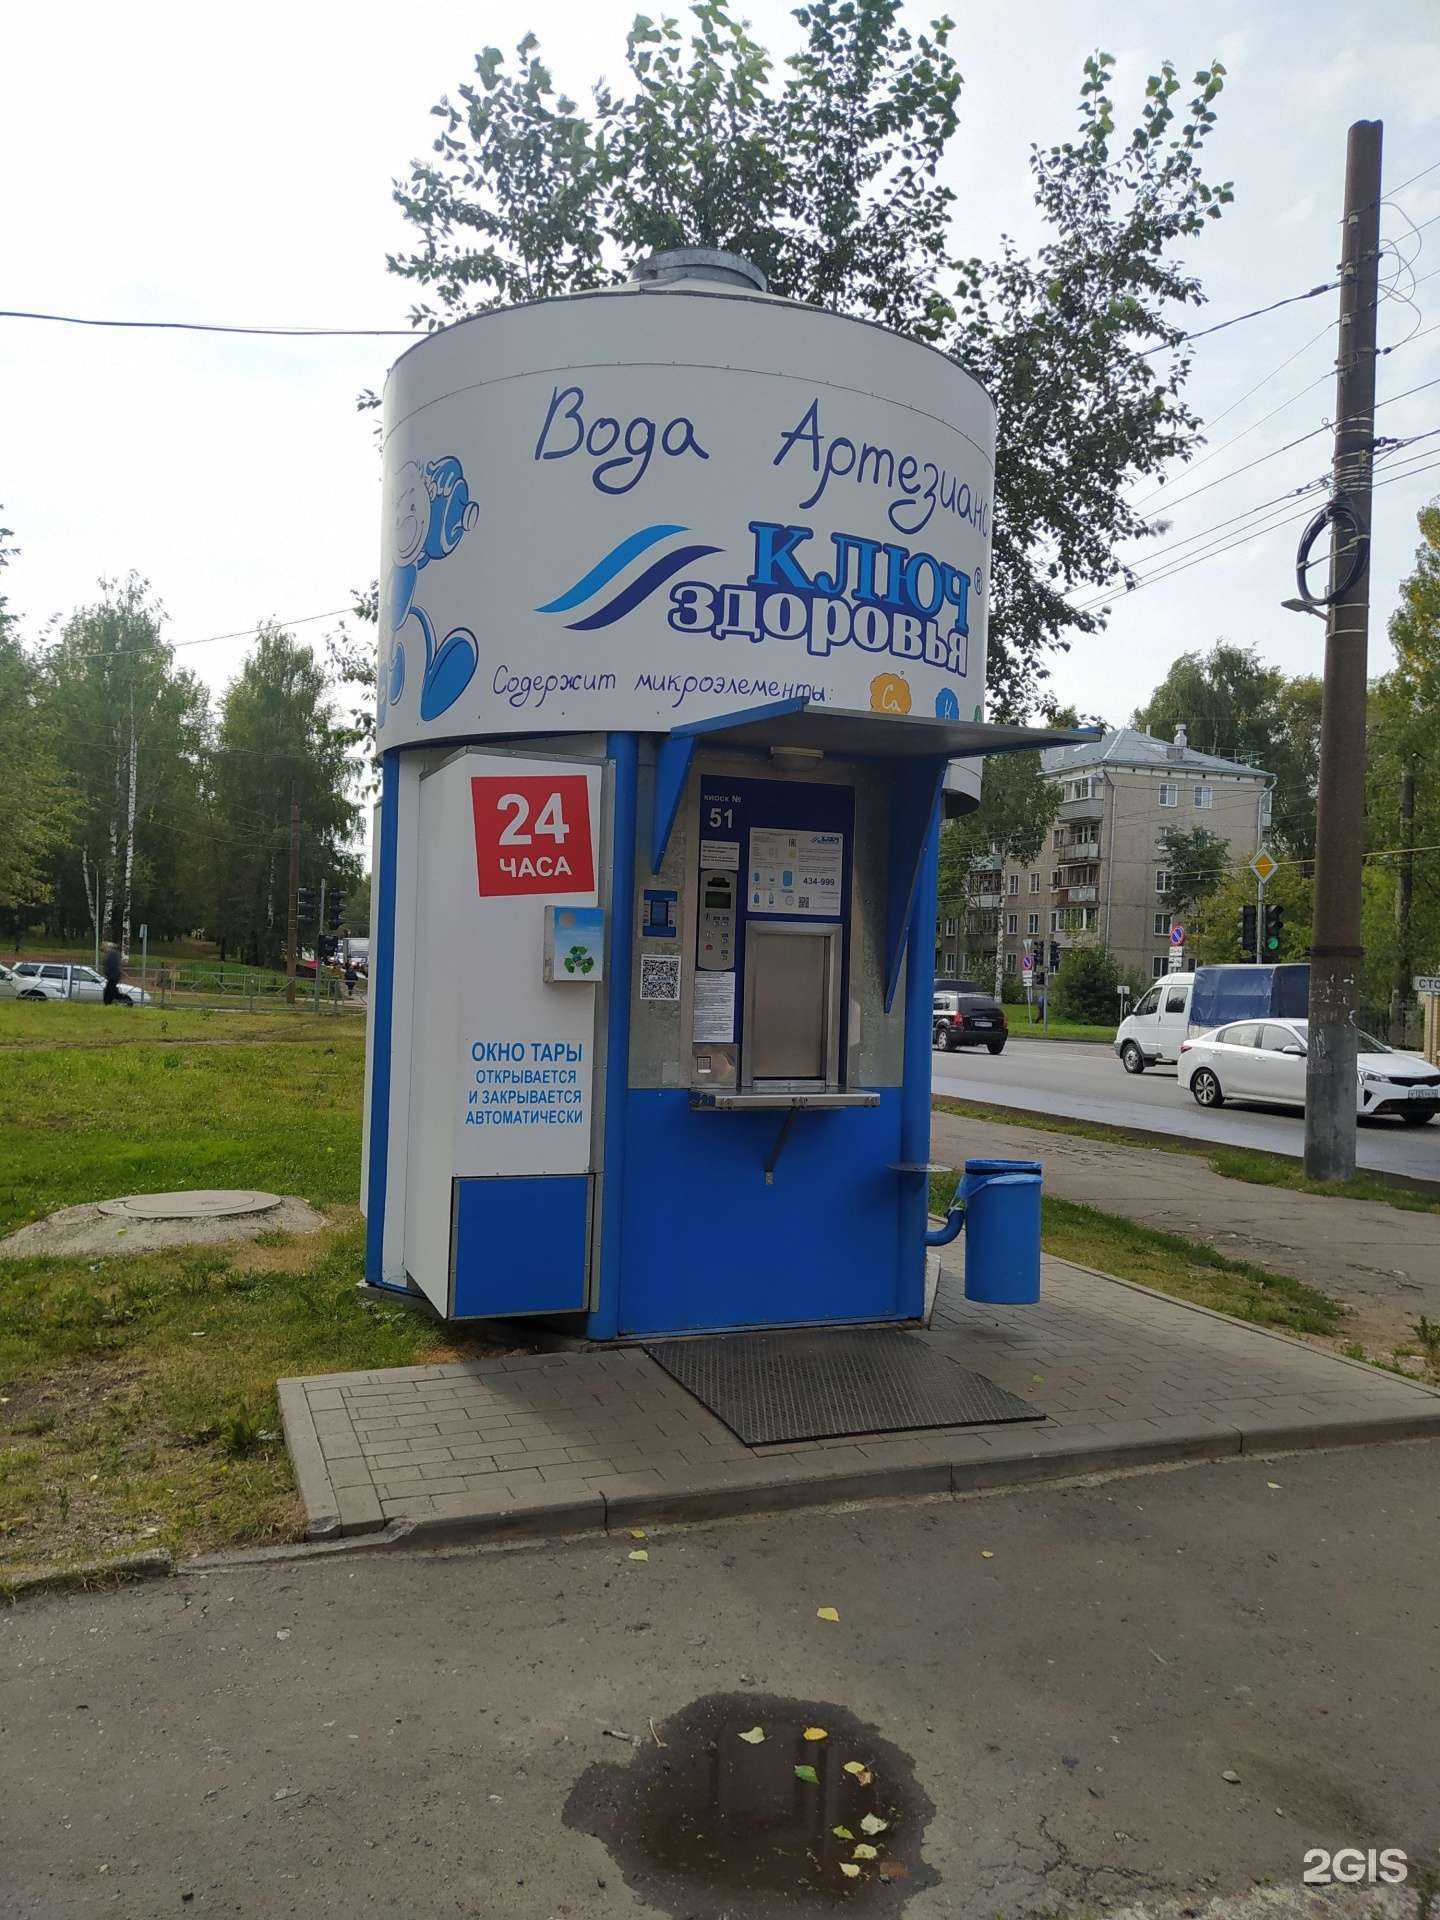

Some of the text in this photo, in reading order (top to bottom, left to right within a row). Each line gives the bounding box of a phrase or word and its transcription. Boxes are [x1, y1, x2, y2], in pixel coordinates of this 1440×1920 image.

[535, 386, 709, 494] Вода
[493, 664, 616, 707] Содержит
[497, 792, 570, 845] 24
[709, 807, 733, 829] 51
[499, 856, 572, 877] ЧАСА
[803, 877, 835, 886] 434-999
[472, 1042, 582, 1062] ОКНО ТАРЫ
[476, 1069, 576, 1084] ОТКРЫВАЕТСЯ
[468, 1089, 582, 1104] И ЗАКРЫВАЕТСЯ
[465, 1110, 583, 1124] АВТОМАТИЧЕСКИ
